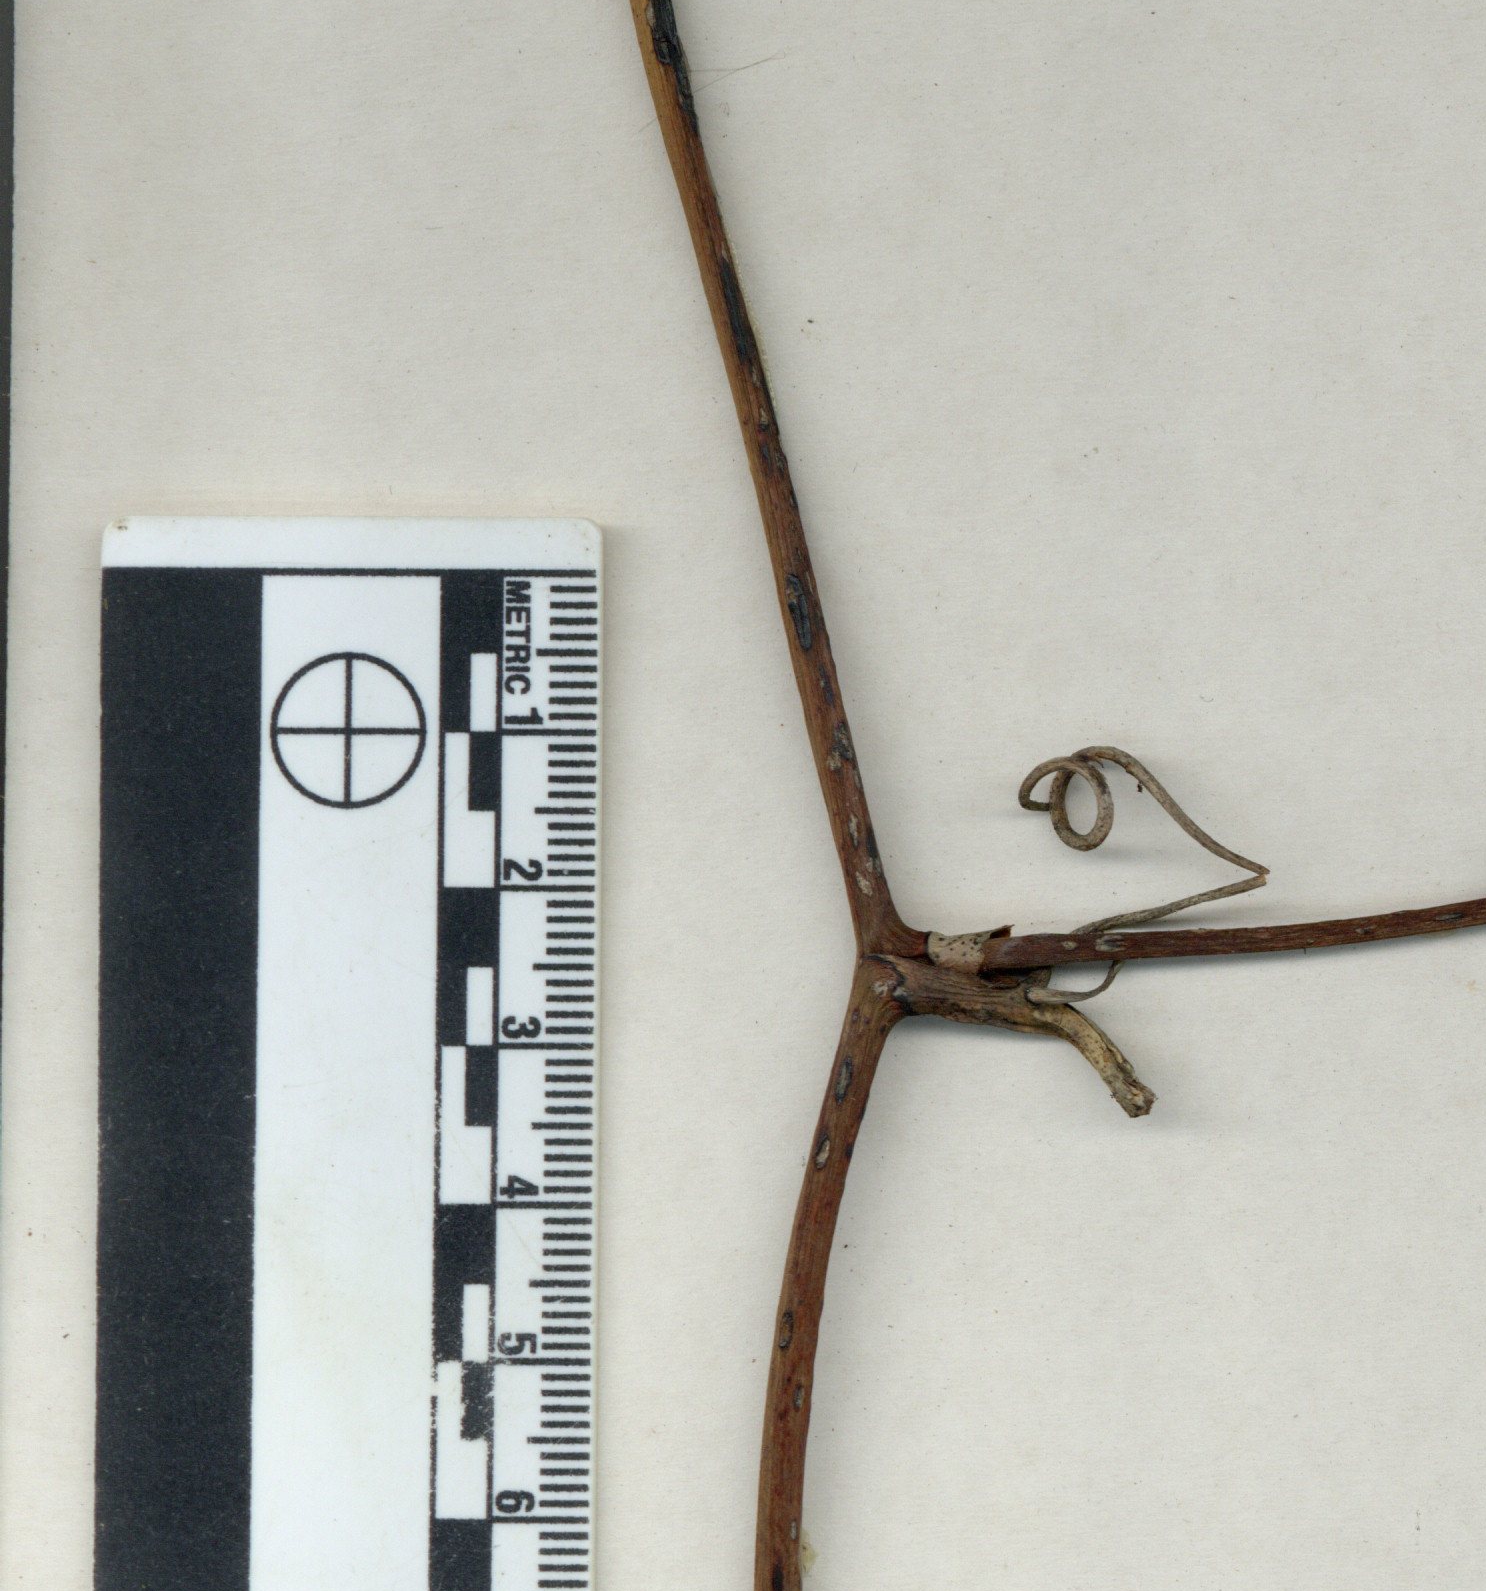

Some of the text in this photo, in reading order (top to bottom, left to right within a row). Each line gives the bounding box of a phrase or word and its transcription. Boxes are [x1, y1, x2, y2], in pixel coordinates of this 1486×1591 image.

[504, 580, 531, 695] METRIC
[504, 707, 544, 725] 1
[503, 858, 543, 882] 2
[501, 1015, 542, 1040] 3
[499, 1175, 540, 1198] 4
[497, 1332, 538, 1355] 5
[496, 1490, 536, 1513] 6
